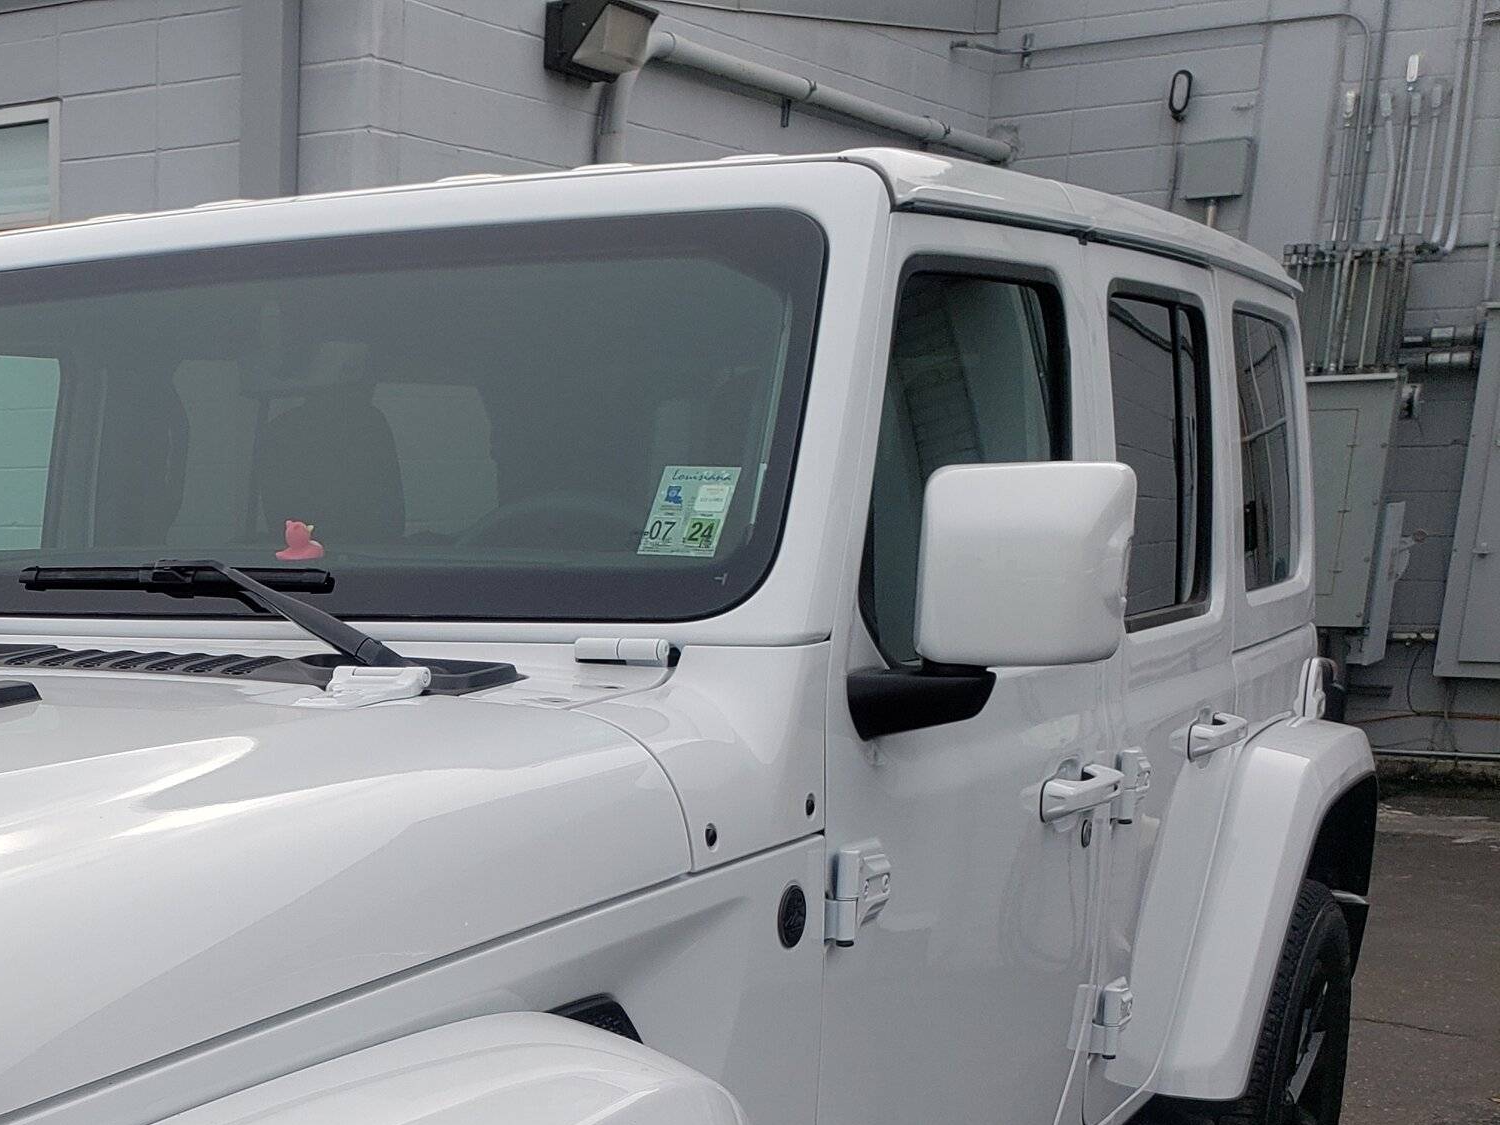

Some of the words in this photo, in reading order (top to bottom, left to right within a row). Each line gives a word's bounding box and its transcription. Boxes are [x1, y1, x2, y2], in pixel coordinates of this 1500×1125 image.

[671, 468, 732, 481] Louisiana
[649, 519, 677, 541] 07
[687, 521, 715, 541] 24
